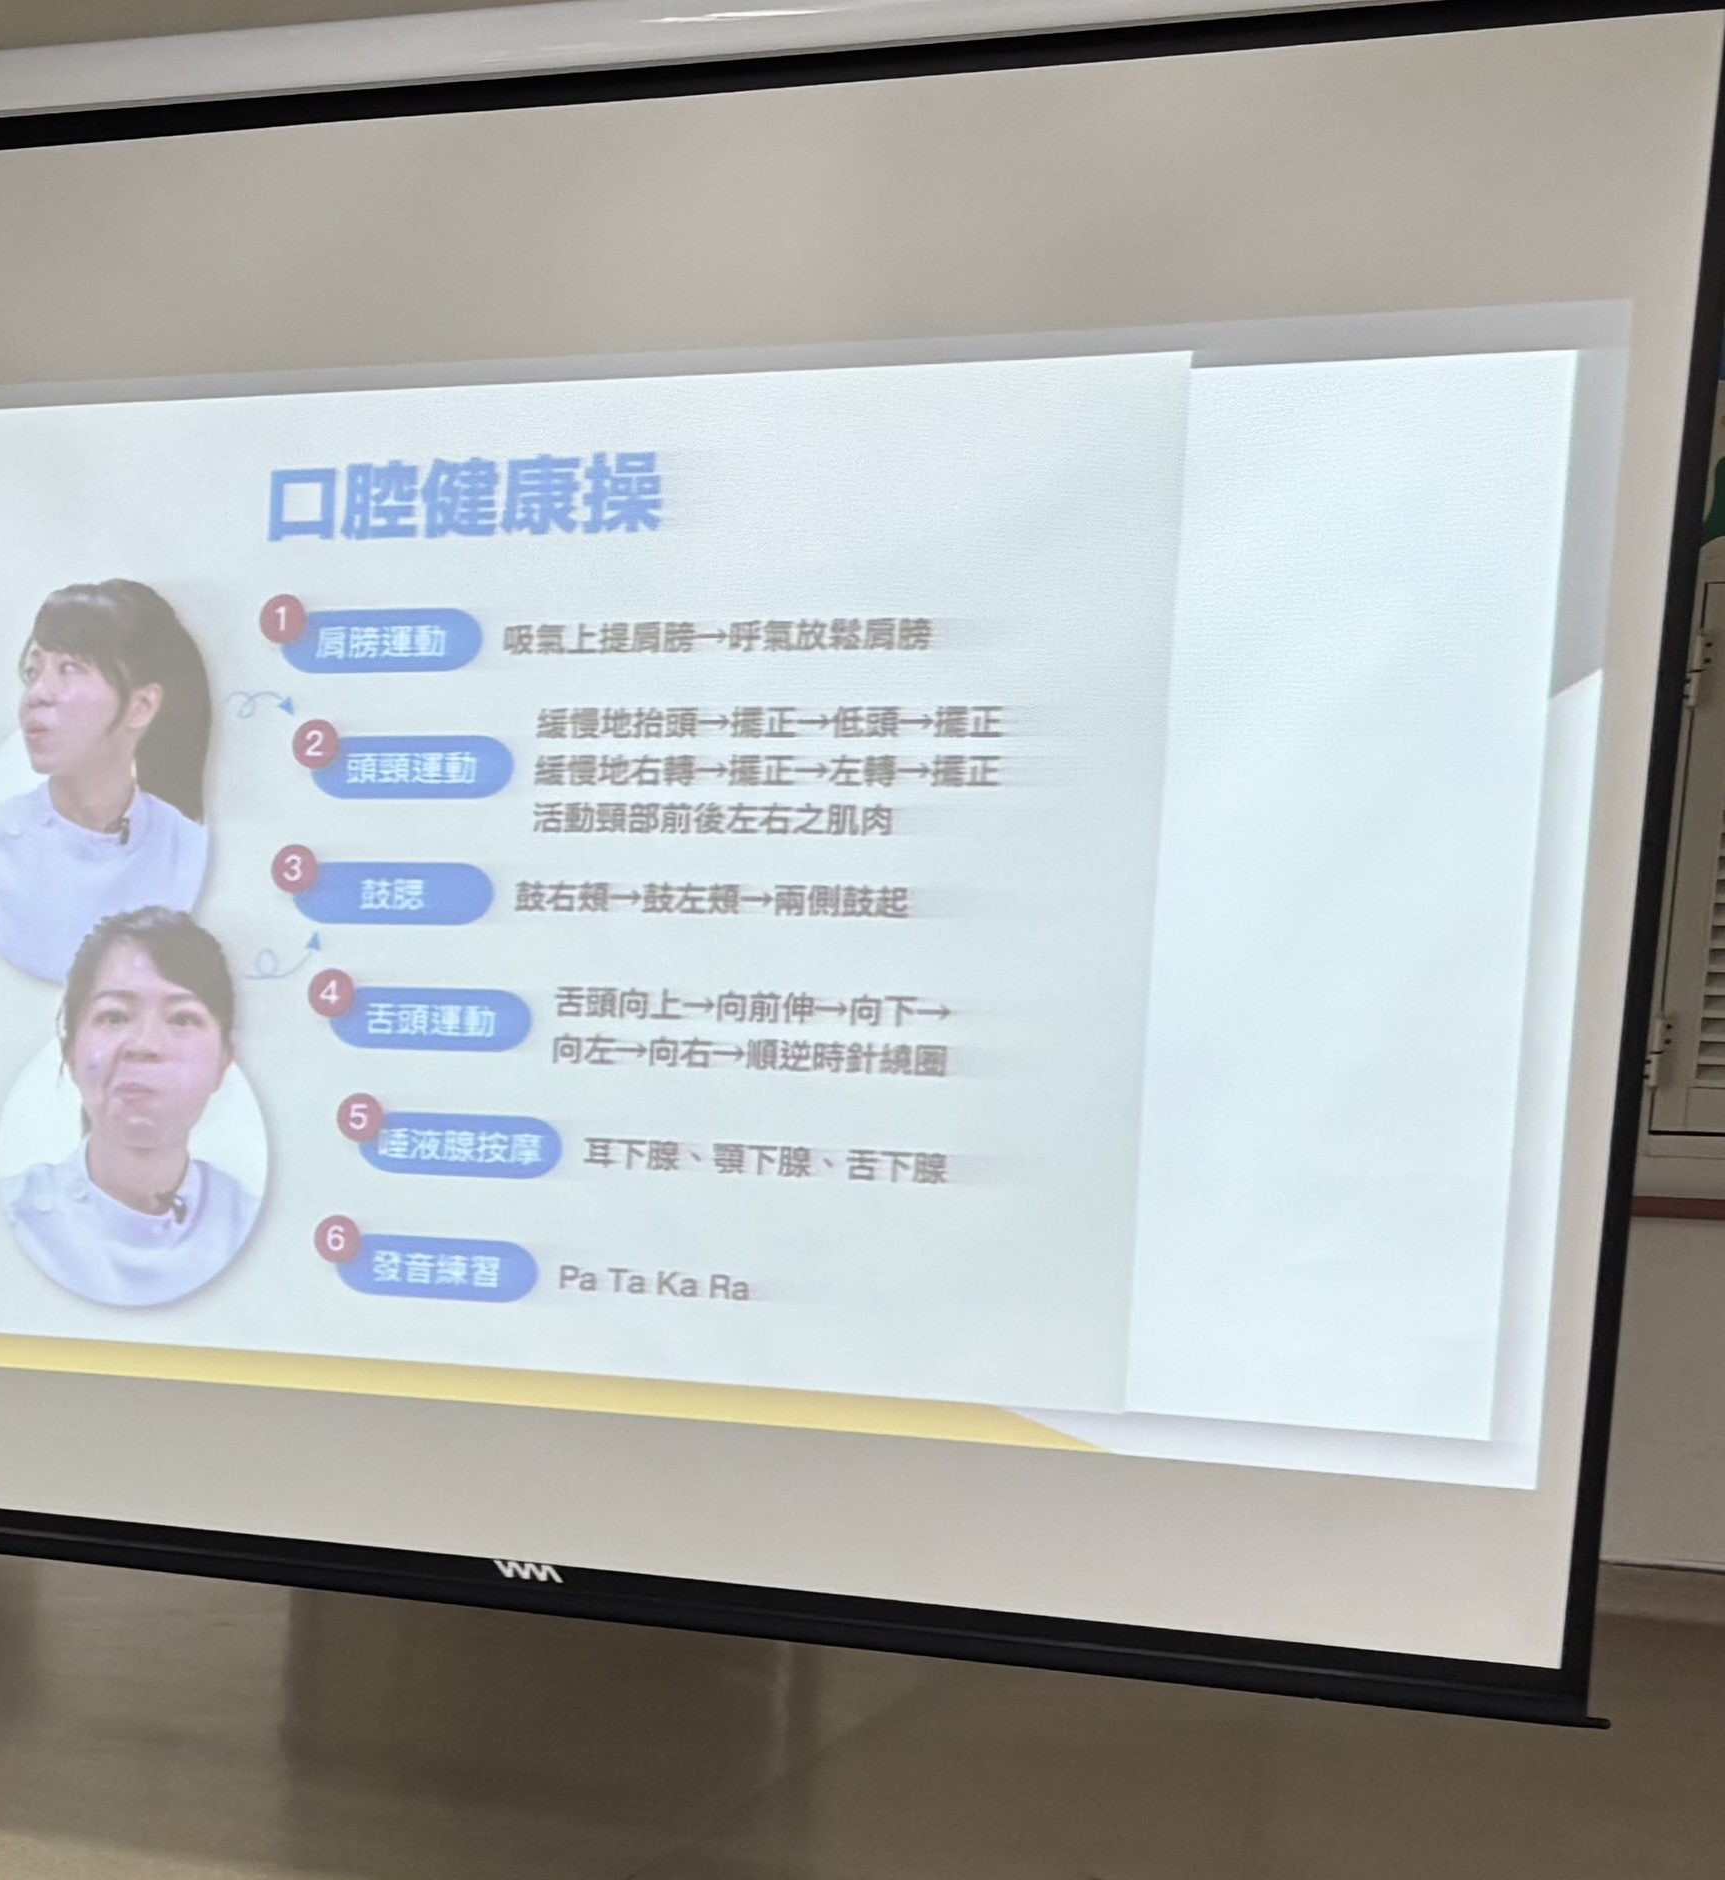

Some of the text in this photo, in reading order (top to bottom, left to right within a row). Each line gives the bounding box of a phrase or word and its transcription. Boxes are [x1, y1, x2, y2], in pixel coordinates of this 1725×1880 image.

[267, 451, 663, 543] 口腔健康操
[274, 606, 447, 659] 1 肩膀運動
[305, 730, 477, 785] 2 頭頸運動
[532, 802, 894, 836] 活動頸部前後左右之肌肉
[283, 855, 302, 882] 3
[319, 980, 496, 1037] 4 舌頭運動
[349, 1104, 543, 1165] 5 唾液腺按摩
[326, 1225, 501, 1288] 6 發音練習
[559, 1265, 750, 1301] Pa Ta Ka Ra
